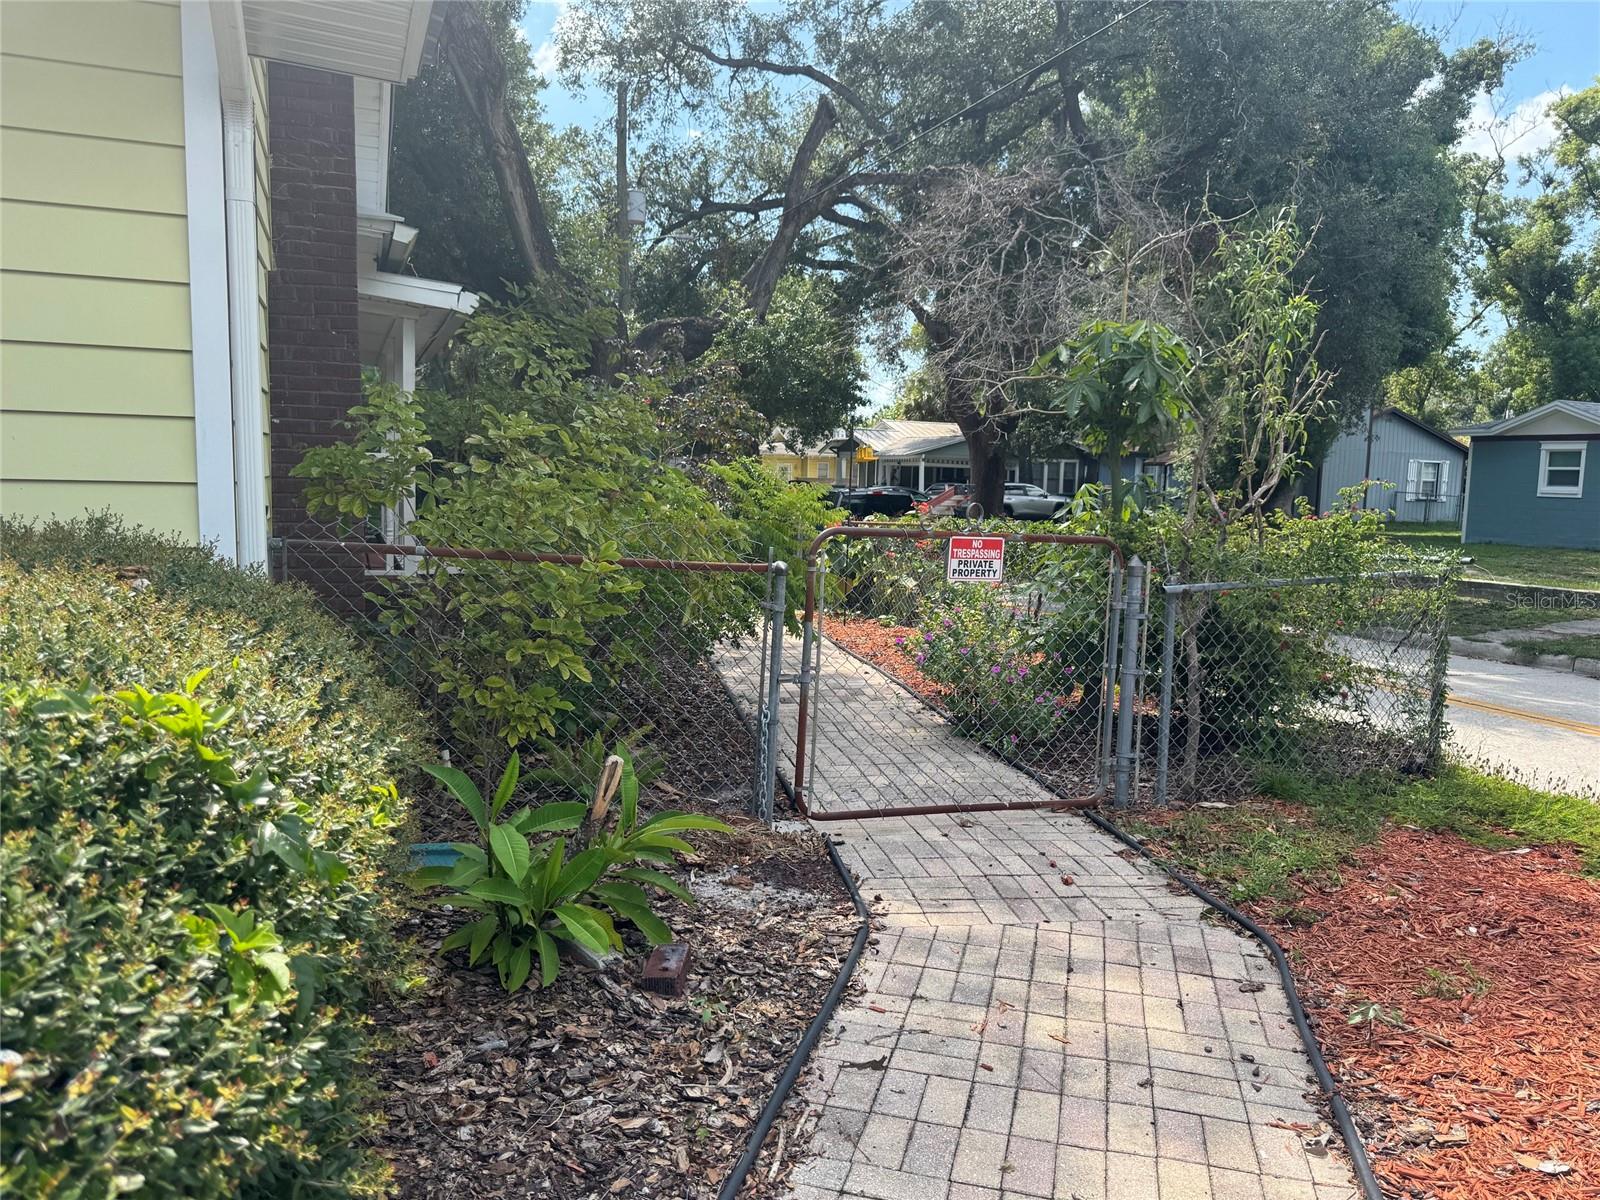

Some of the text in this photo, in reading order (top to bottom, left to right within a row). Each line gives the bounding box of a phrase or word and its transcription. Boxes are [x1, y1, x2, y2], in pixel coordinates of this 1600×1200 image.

[972, 540, 983, 548] NO
[952, 549, 1000, 559] TRESPASSING
[957, 560, 994, 568] PRIVATE
[952, 569, 998, 577] PROPERTY
